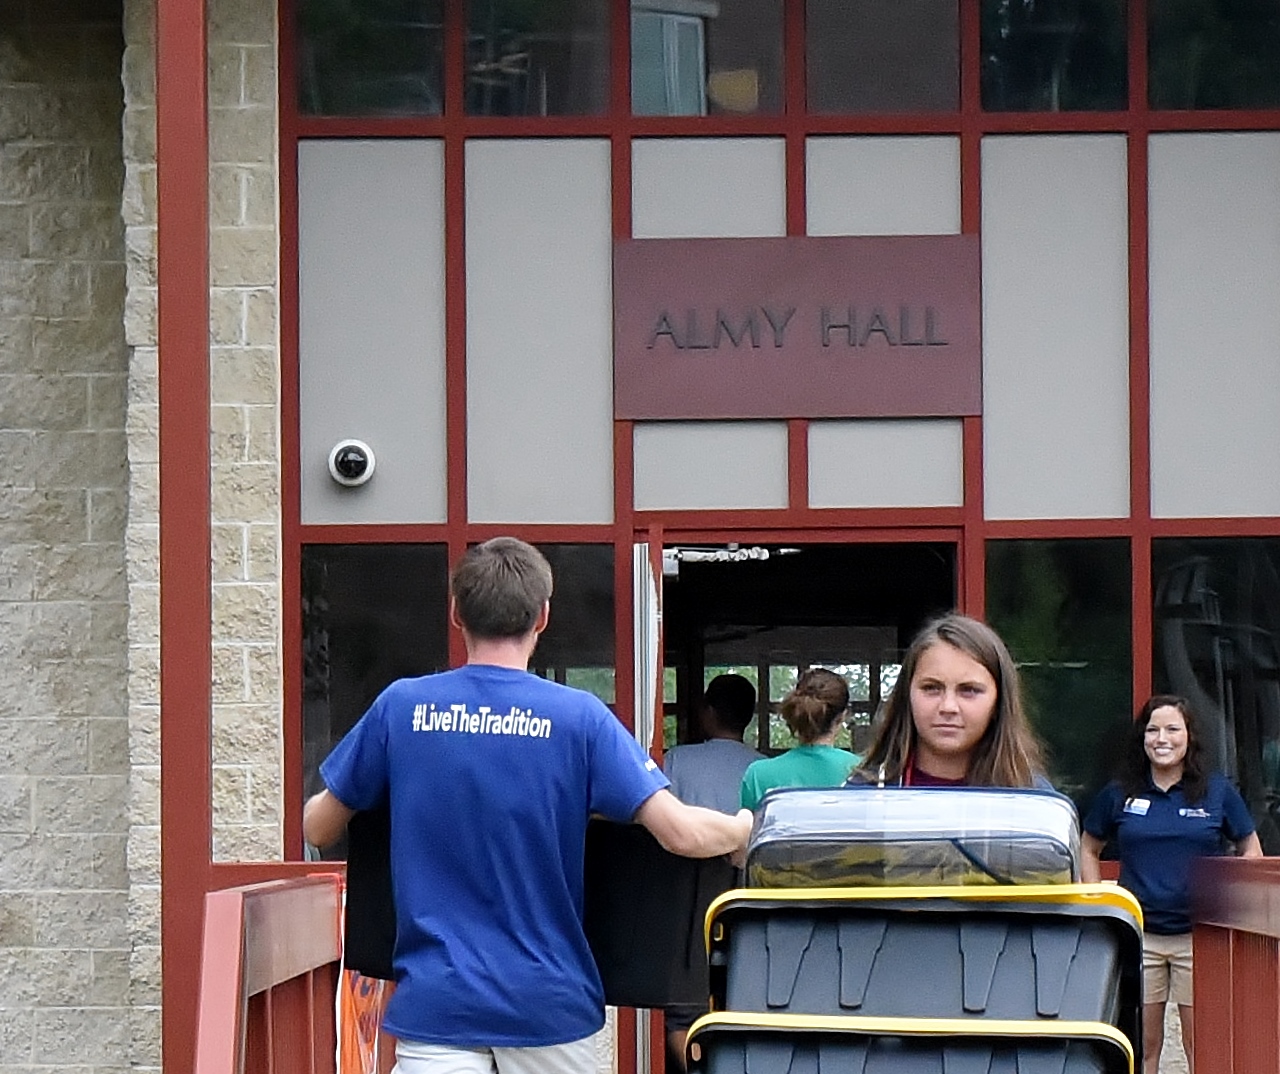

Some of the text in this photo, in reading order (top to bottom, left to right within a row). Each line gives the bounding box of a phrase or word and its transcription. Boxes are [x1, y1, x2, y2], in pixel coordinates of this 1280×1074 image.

[646, 304, 949, 349] ALMY HALL
[412, 703, 552, 739] #LiveTheTradition
